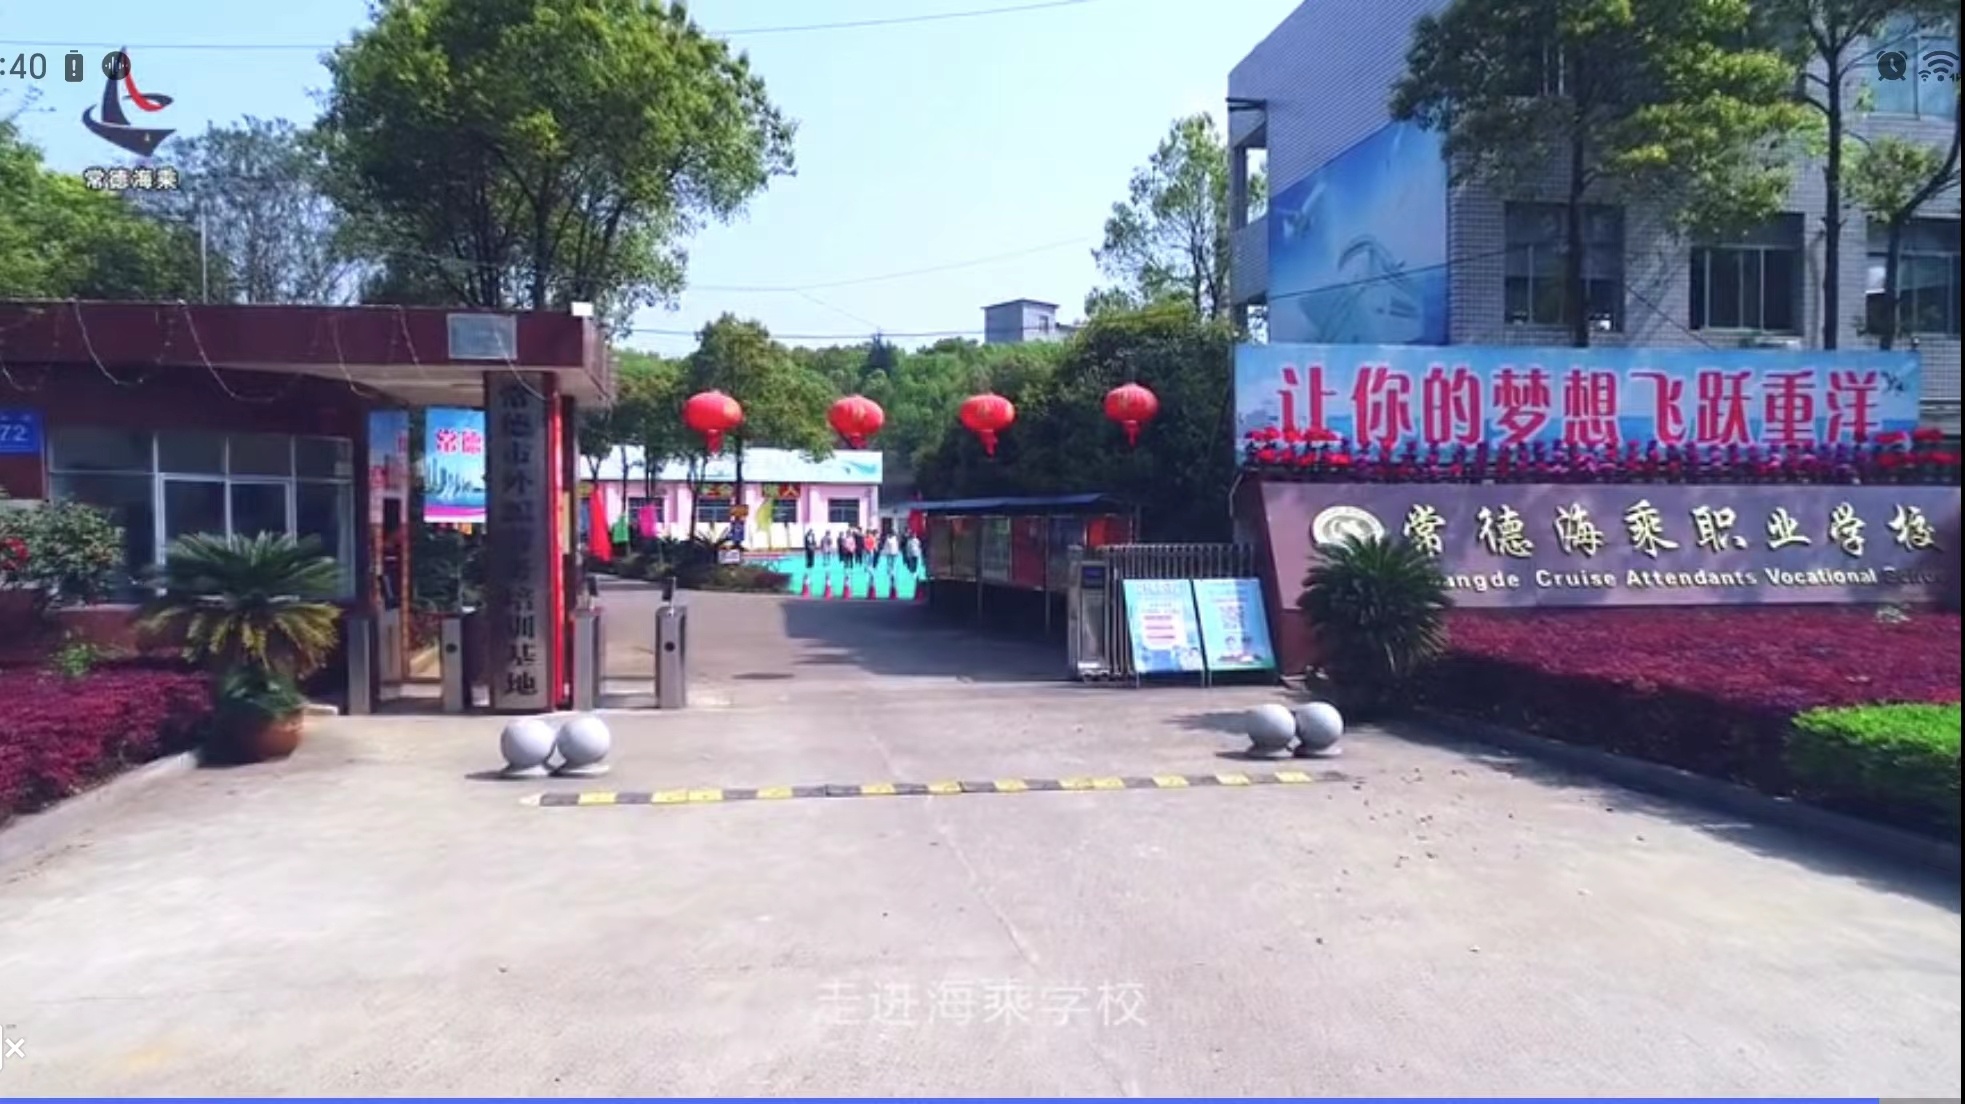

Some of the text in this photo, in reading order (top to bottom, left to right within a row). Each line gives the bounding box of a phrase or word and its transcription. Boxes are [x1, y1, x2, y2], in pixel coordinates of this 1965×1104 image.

[1277, 365, 1882, 450] 让你的梦想飞跃重洋
[1403, 499, 1942, 558] 常德海乘职业学校
[1535, 569, 1617, 588] Cruise
[1626, 569, 1757, 588] Attendants
[1765, 567, 1878, 586] Vocational
